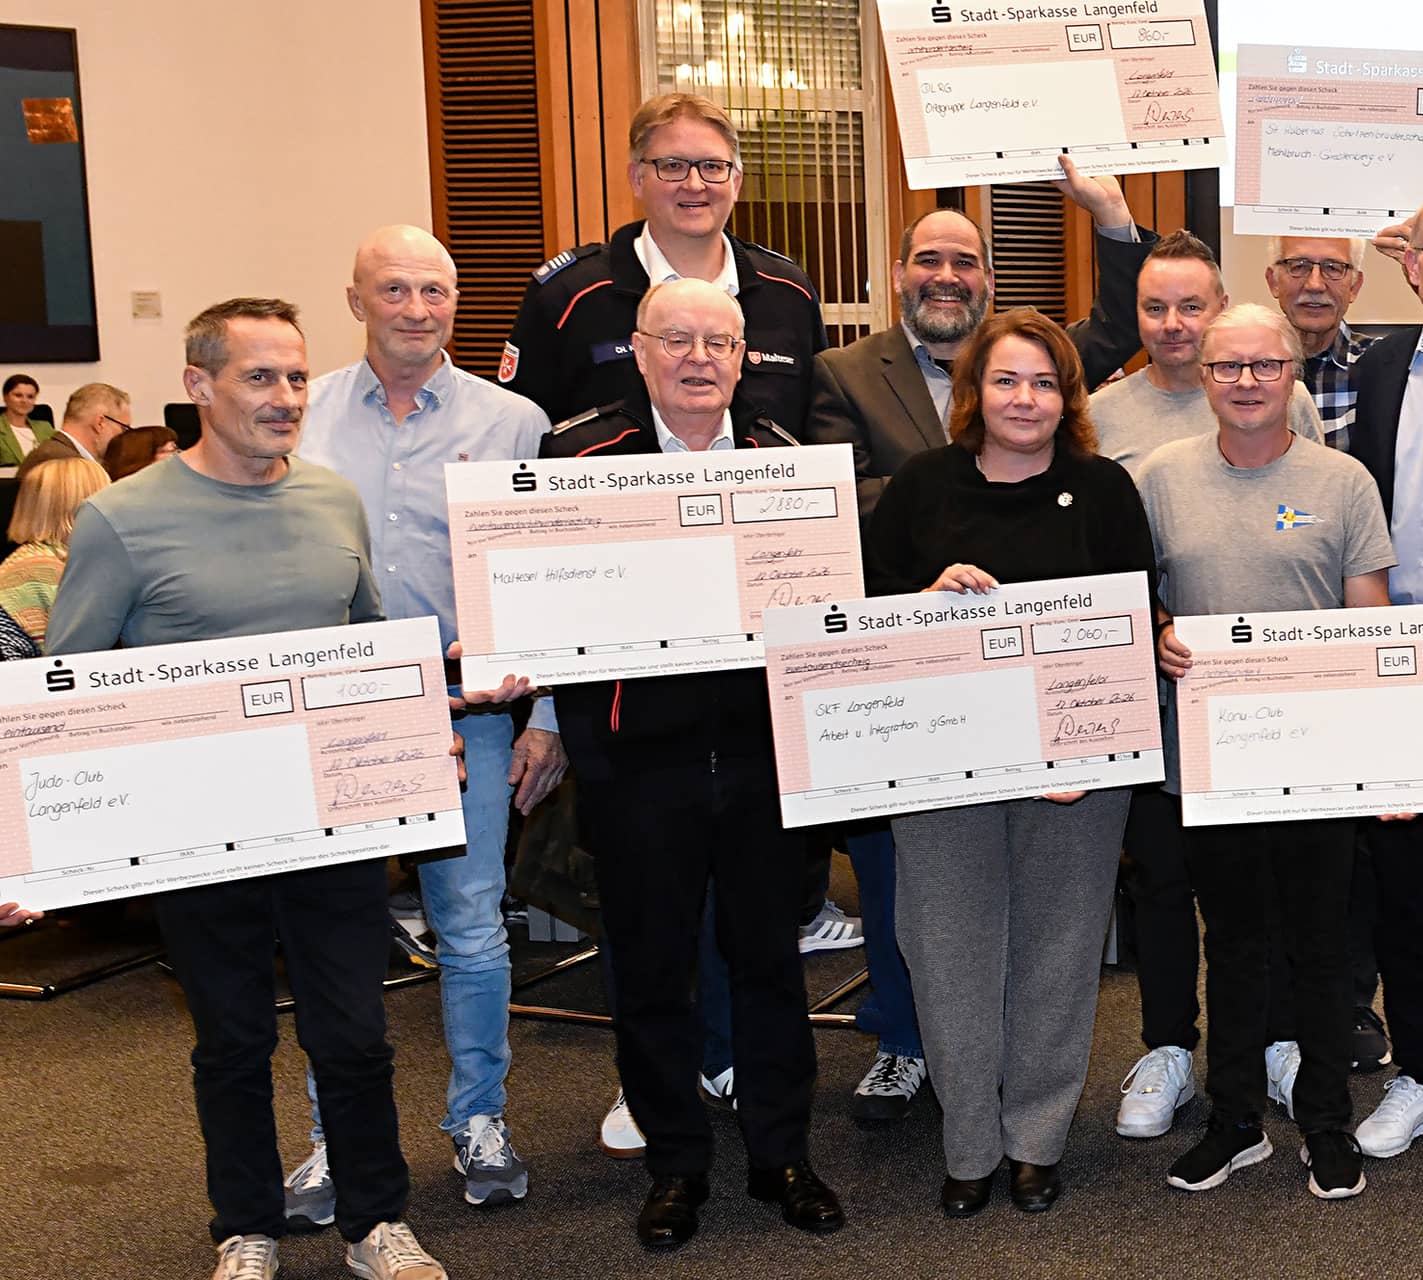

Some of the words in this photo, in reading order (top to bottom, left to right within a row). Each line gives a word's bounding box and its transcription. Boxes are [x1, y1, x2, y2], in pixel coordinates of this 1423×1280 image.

[1084, 1, 1157, 18] Langenfeld
[1073, 33, 1096, 43] EUR
[704, 464, 795, 484] Langenfeld
[465, 509, 489, 518] Zahlen
[491, 508, 503, 516] Sie
[504, 508, 527, 517] gegen
[529, 506, 553, 514] diesen
[554, 504, 579, 512] Scheck
[687, 505, 715, 516] EUR
[1005, 593, 1092, 616] Langenfeld
[989, 637, 1016, 649] EUR
[269, 641, 374, 667] Langenfeld
[1384, 656, 1409, 667] EUR
[251, 692, 284, 706] EUR
[847, 696, 904, 716] Langenfeld
[22, 711, 36, 720] Sie
[38, 709, 65, 720] gegen
[67, 704, 95, 715] diesen
[97, 701, 126, 712] Scheck
[29, 797, 102, 821] Langenfeld
